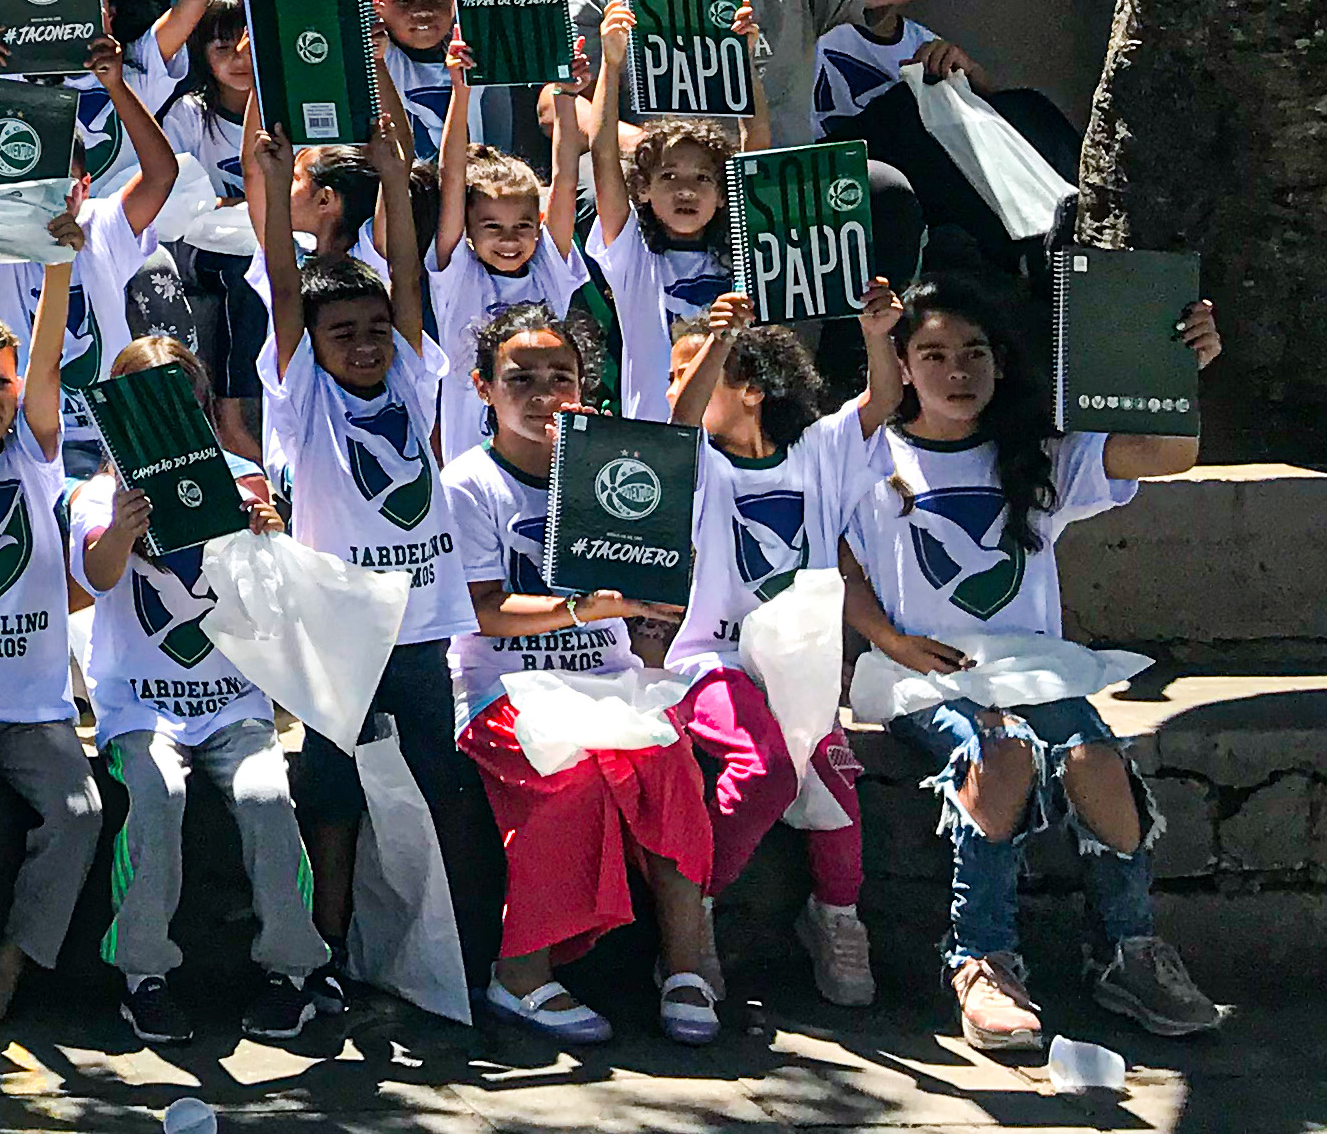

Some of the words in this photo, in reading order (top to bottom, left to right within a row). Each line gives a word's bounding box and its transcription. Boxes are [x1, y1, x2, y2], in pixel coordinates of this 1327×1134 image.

[3, 23, 95, 45] #JACONERO
[645, 34, 747, 110] PAPO
[754, 220, 869, 322] PAPO
[174, 455, 187, 468] DO
[188, 446, 218, 464] BRASIL
[570, 537, 679, 568] #JACONERO
[522, 651, 605, 672] RAMOS
